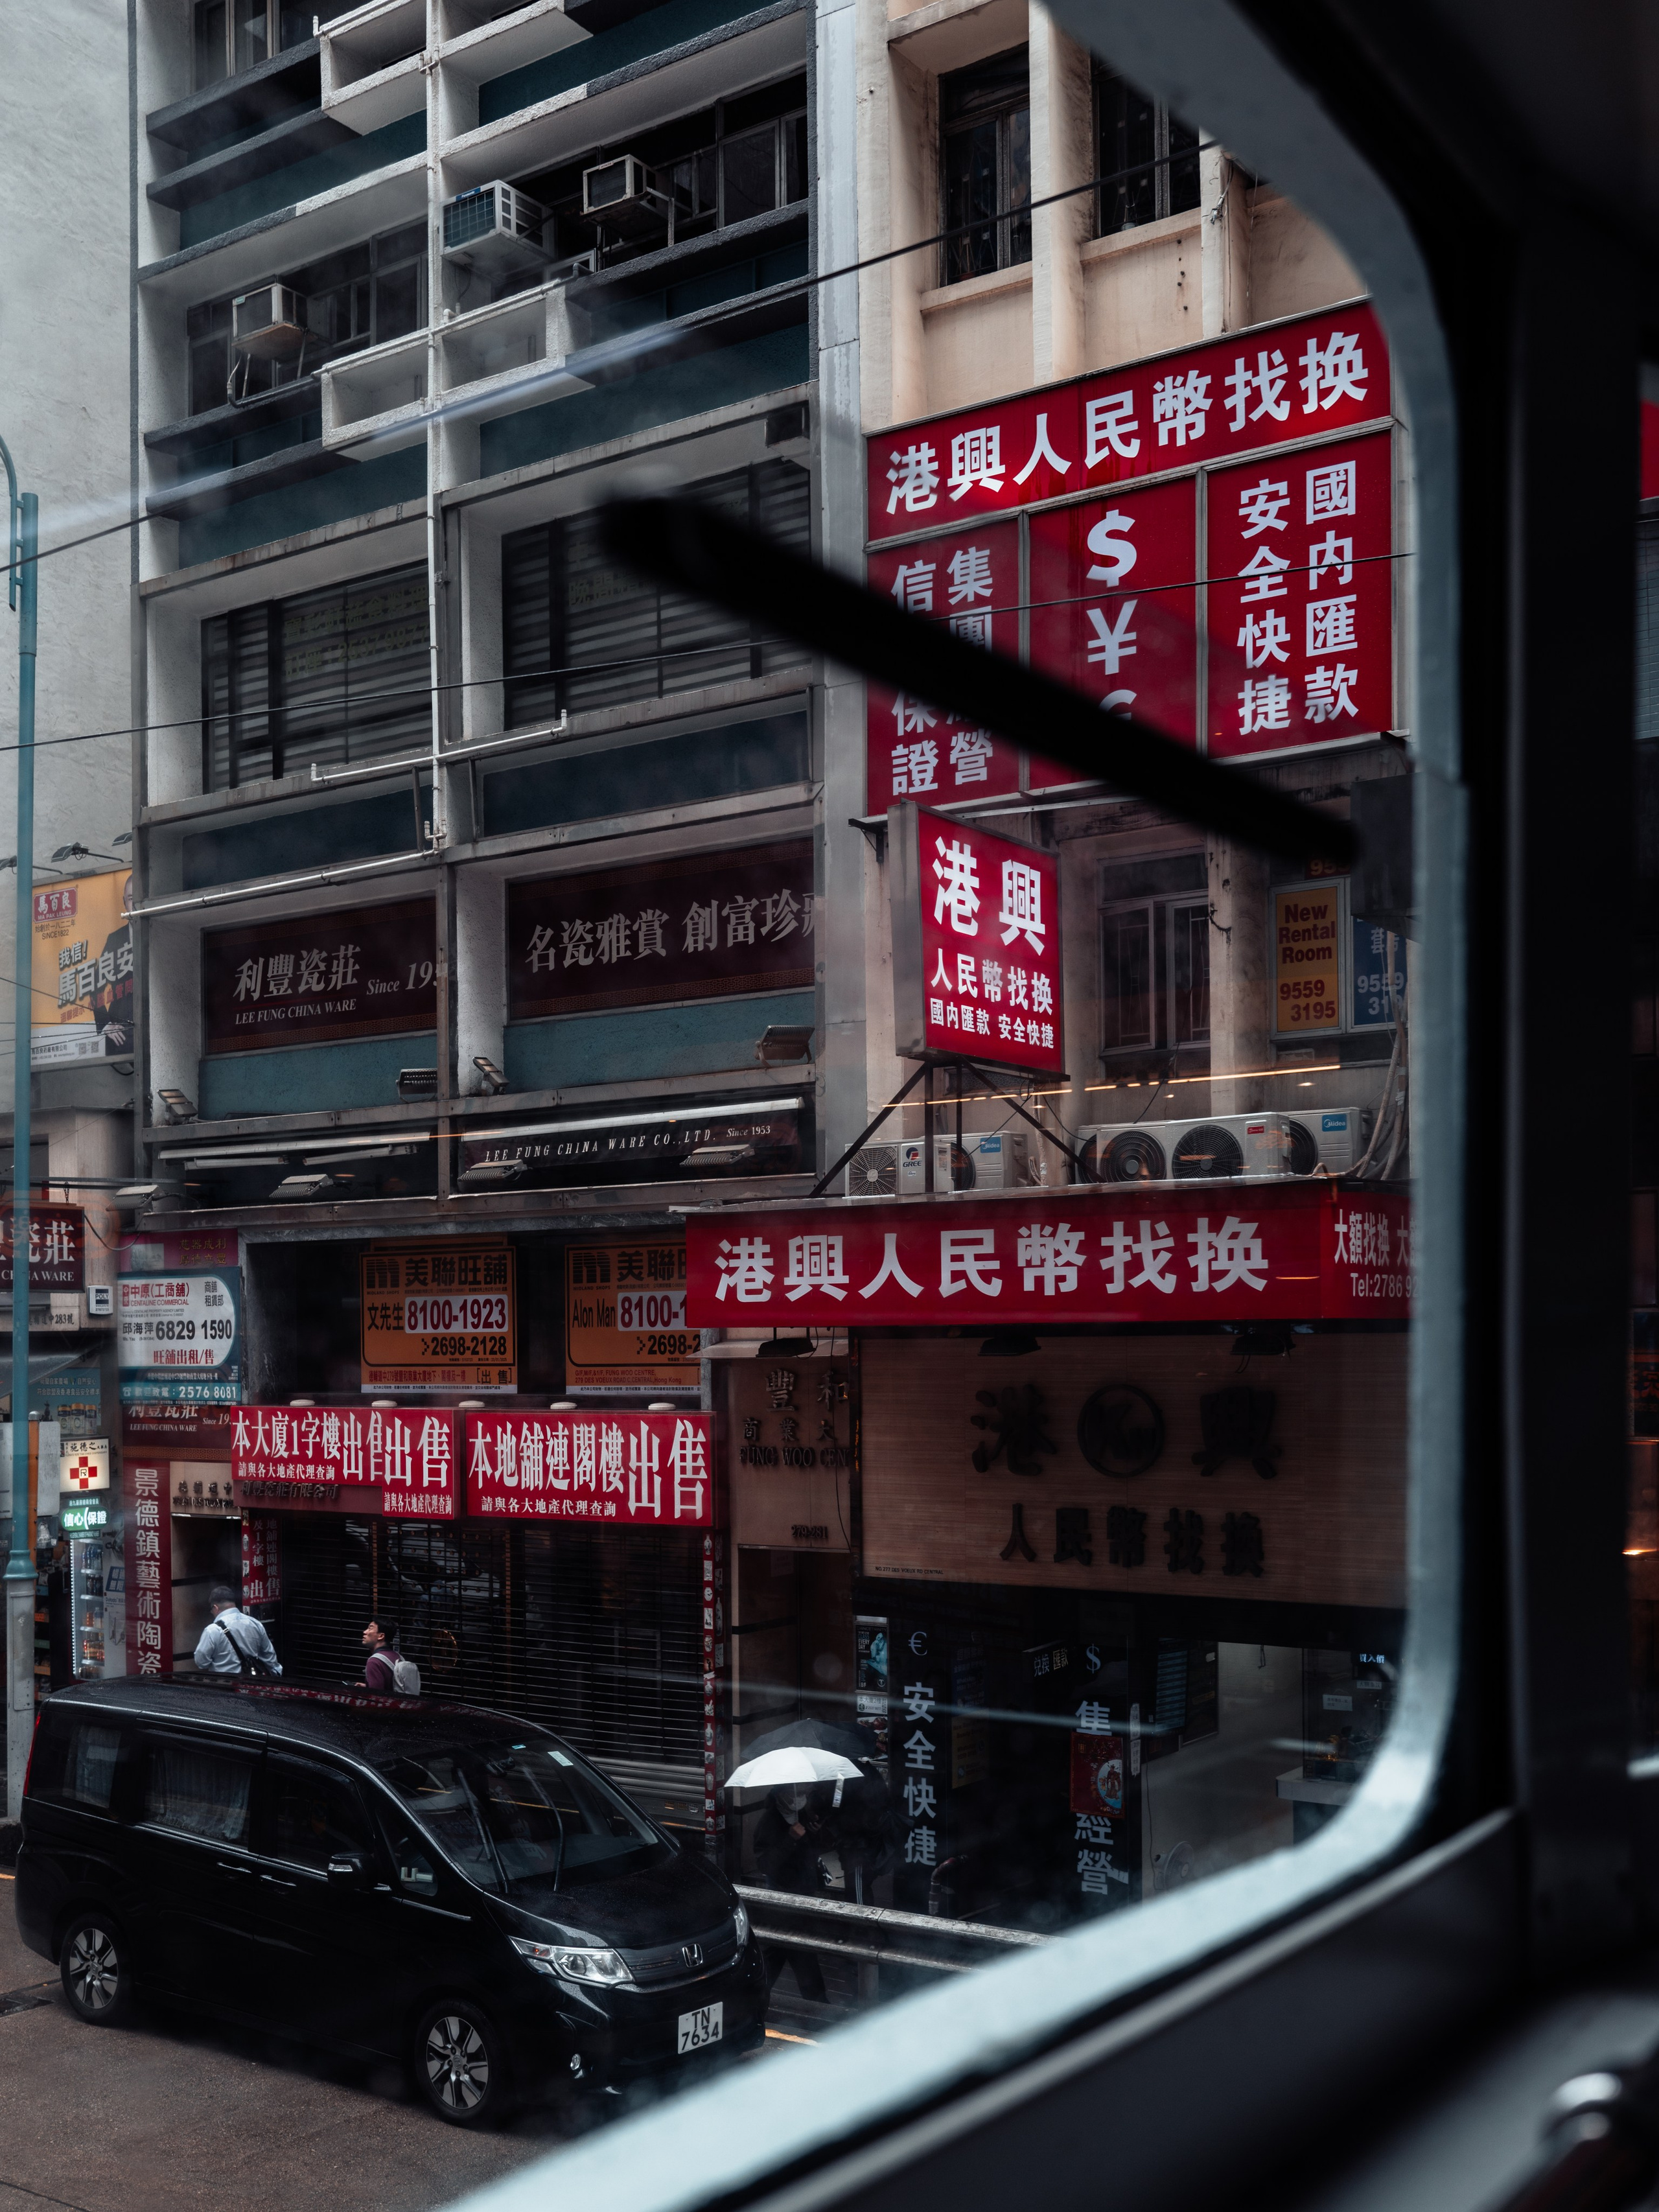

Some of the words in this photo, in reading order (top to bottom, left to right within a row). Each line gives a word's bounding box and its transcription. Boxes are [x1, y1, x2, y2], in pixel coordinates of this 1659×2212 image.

[1086, 509, 1137, 587] $
[1237, 478, 1292, 736] 安全快捷
[1087, 600, 1137, 675] ¥
[890, 559, 939, 796] 信保證
[946, 546, 993, 786] 集團營
[38, 892, 72, 914] 馬百良
[932, 835, 1046, 956] 港興
[1285, 904, 1328, 924] New
[525, 908, 669, 973] 名瓷雅賞
[1279, 921, 1336, 944] Rental
[1282, 946, 1332, 964] Room
[233, 944, 362, 1002] 利豐瓷莊
[367, 979, 400, 995] Since
[405, 960, 437, 990] 19
[1280, 979, 1325, 1000] 9559
[235, 1011, 255, 1025] LEE
[257, 1007, 286, 1022] FUNG
[287, 1005, 321, 1019] CHINA
[325, 998, 356, 1013] WARE
[1291, 1001, 1336, 1021] 3195
[998, 1013, 1054, 1050] 安全快捷
[1323, 1119, 1346, 1128] Midea
[485, 1149, 508, 1162] LEE
[516, 1145, 550, 1159] FUNG
[557, 1141, 597, 1155] CHINA
[609, 1135, 645, 1150] WARE
[726, 1128, 748, 1137] Since
[752, 1125, 771, 1135] 1953
[0, 1218, 75, 1265] 瓷莊
[41, 1270, 75, 1281] WARE
[405, 1254, 508, 1286] 美聯旺舖
[367, 1302, 404, 1331] 文先生
[407, 1298, 506, 1331] 8100-1923
[597, 1298, 616, 1328] Man
[122, 1322, 154, 1335] 邱海萍
[156, 1320, 195, 1340] 6829
[201, 1319, 232, 1340] 1590
[431, 1336, 507, 1356] 2698-2128
[179, 1386, 210, 1399] 2576
[214, 1386, 237, 1399] 8081
[142, 1423, 159, 1432] FUNG
[218, 1414, 231, 1425] 19
[384, 1415, 452, 1489] 出售
[739, 1446, 776, 1466] FUNG
[781, 1447, 814, 1467] WOO
[238, 1461, 336, 1482] 請與各大地產代理查詢
[469, 1417, 709, 1520] 本地舖連閣樓出售
[384, 1491, 452, 1516] 請與各大地產代理查詢
[481, 1496, 617, 1518] 請與各大地產代理查詢
[791, 1524, 828, 1539] 279-281
[135, 1467, 161, 1676] 景德鎮藝術陶瓷
[250, 1577, 281, 1600] 出售
[908, 1631, 927, 1656] €
[1085, 1643, 1102, 1674] $
[903, 1682, 937, 1867] 安全快捷
[1074, 1700, 1114, 1895] 集經營
[691, 2007, 710, 2029] TN
[681, 2021, 719, 2051] 7634
